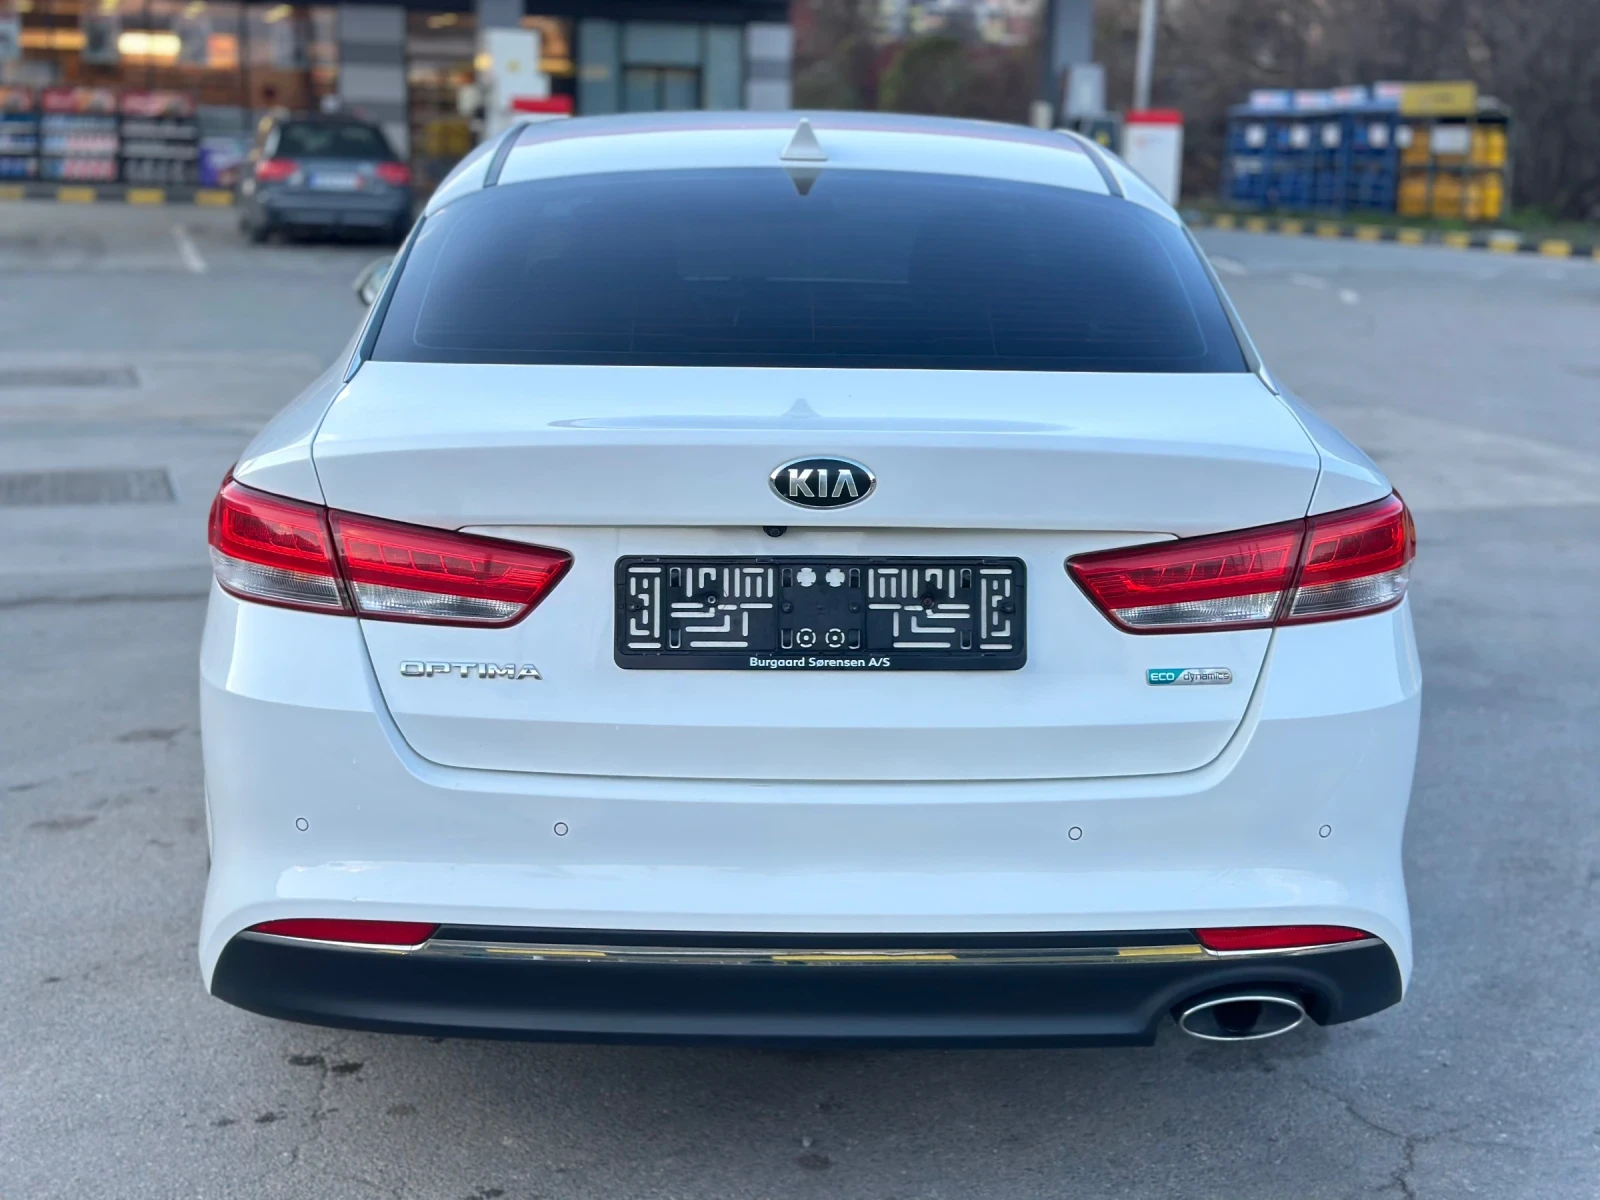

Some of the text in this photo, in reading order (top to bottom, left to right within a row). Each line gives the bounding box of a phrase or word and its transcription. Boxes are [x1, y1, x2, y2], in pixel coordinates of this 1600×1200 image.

[788, 468, 859, 498] KIA
[400, 660, 543, 680] OPTIMA
[749, 656, 890, 669] Burgaard Sørensen A/S
[1150, 671, 1230, 682] ECO dynamics
